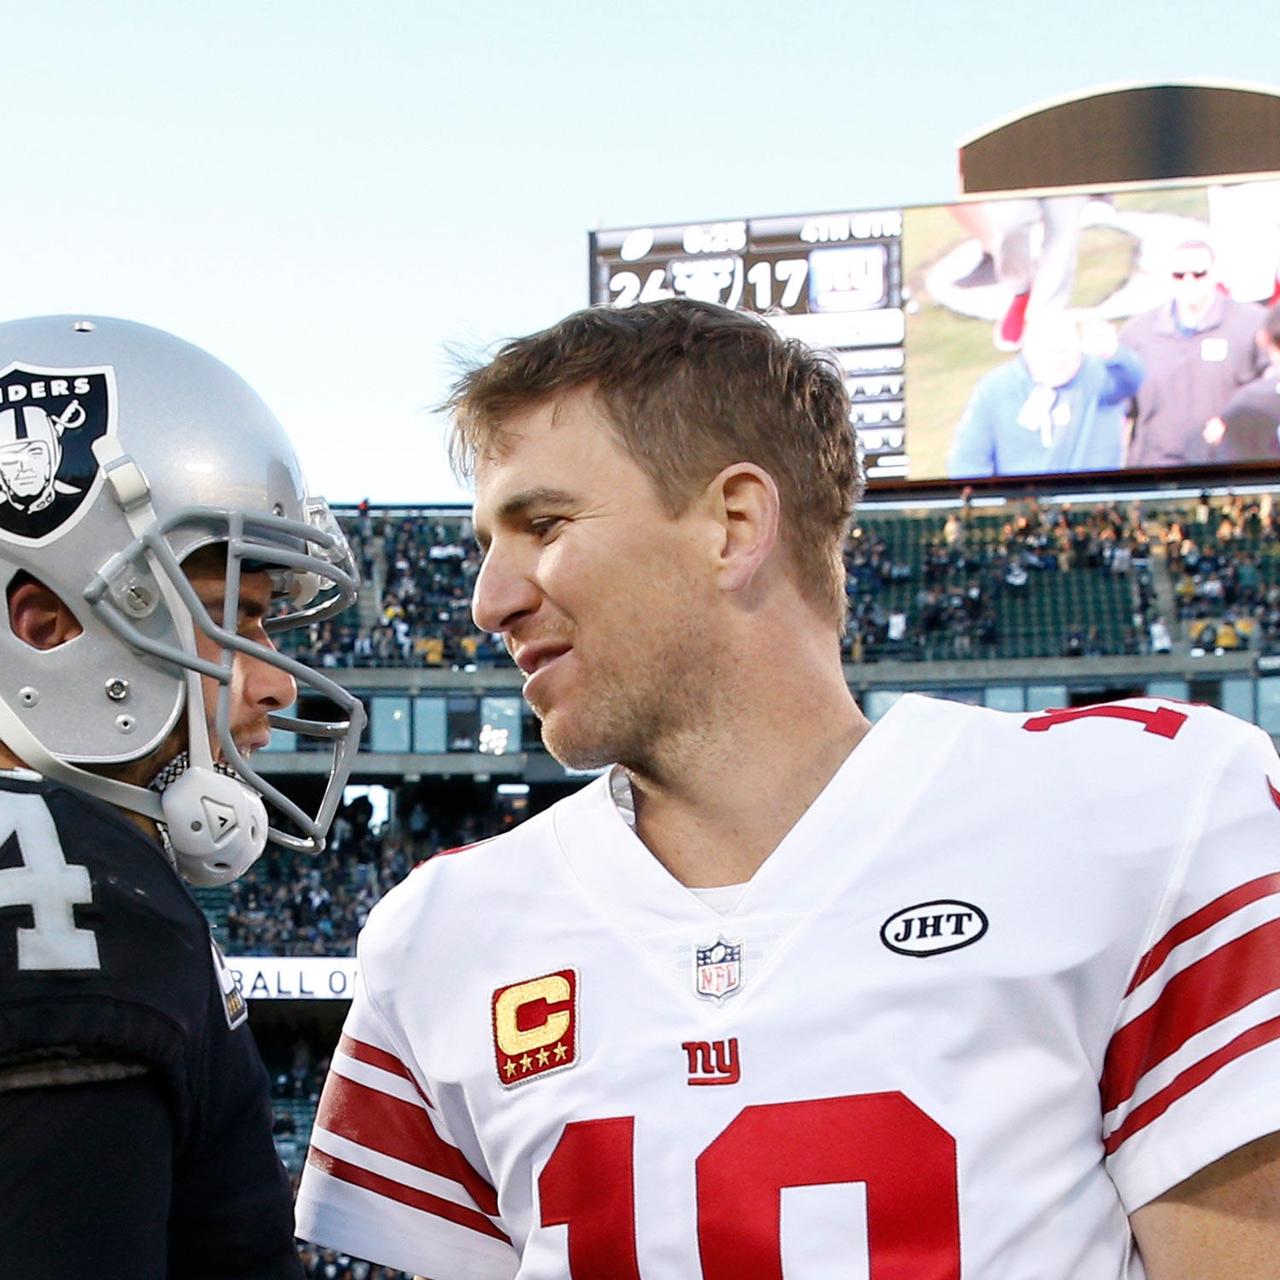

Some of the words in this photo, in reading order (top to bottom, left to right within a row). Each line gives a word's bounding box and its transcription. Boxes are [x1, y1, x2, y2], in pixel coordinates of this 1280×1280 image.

[747, 259, 809, 309] 17
[893, 912, 973, 943] JHT
[328, 970, 358, 994] O
[701, 963, 737, 992] NFL
[495, 975, 575, 1055] C
[681, 1037, 741, 1087] ny
